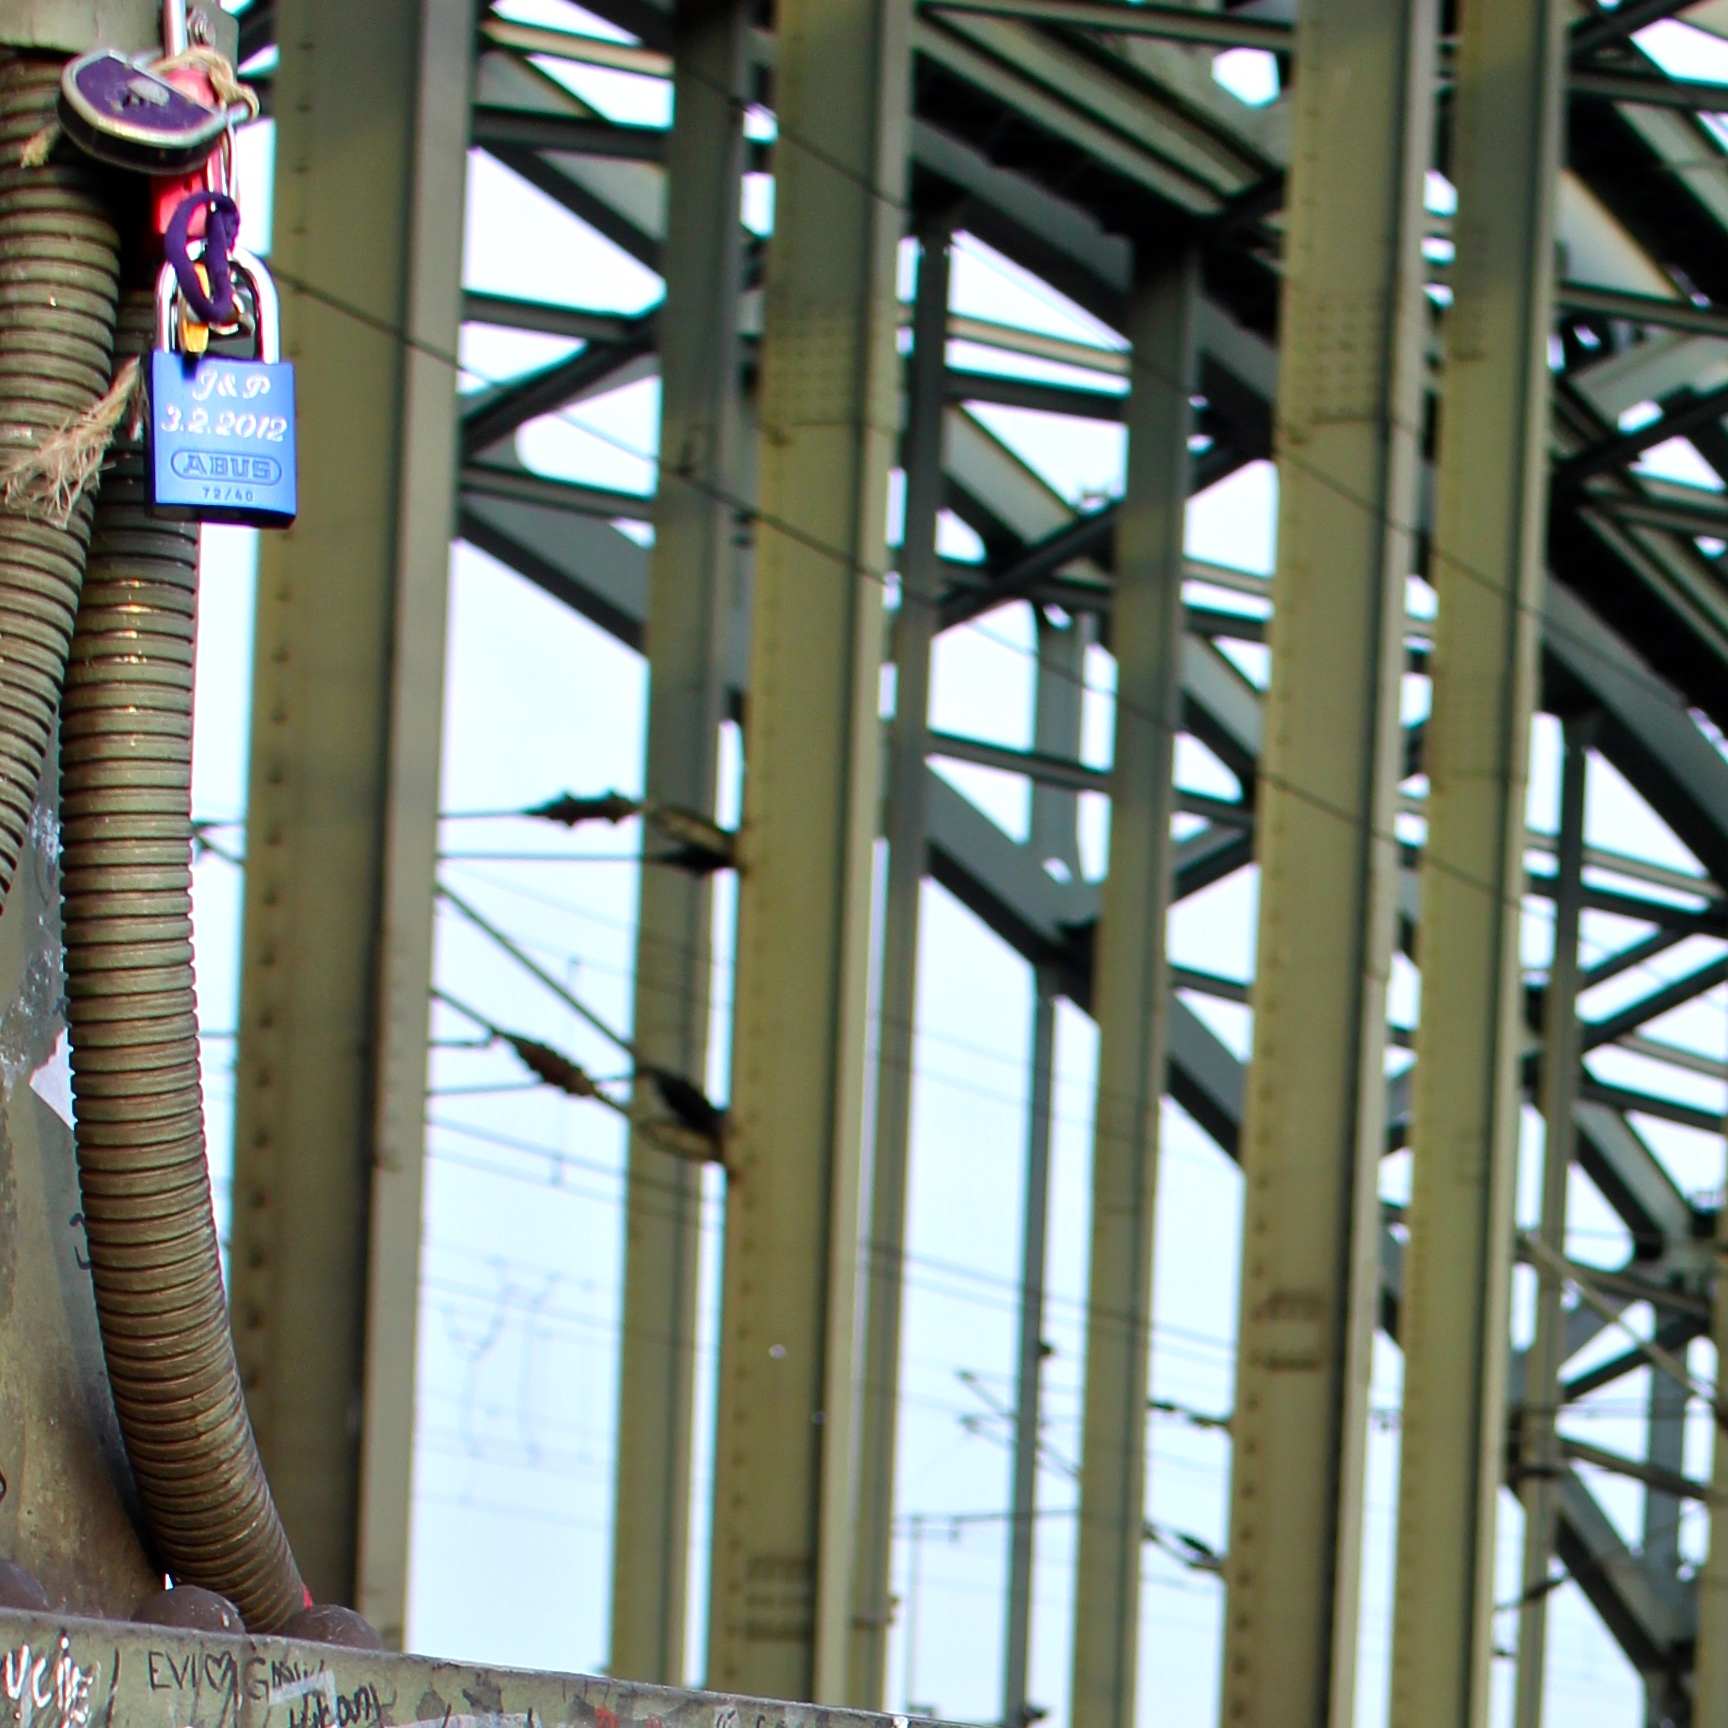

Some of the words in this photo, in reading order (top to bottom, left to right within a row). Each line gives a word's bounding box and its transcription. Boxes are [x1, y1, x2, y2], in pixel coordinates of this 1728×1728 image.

[161, 404, 287, 442] 3.2.2012
[183, 454, 271, 480] ABUS
[202, 486, 253, 502] 72/40
